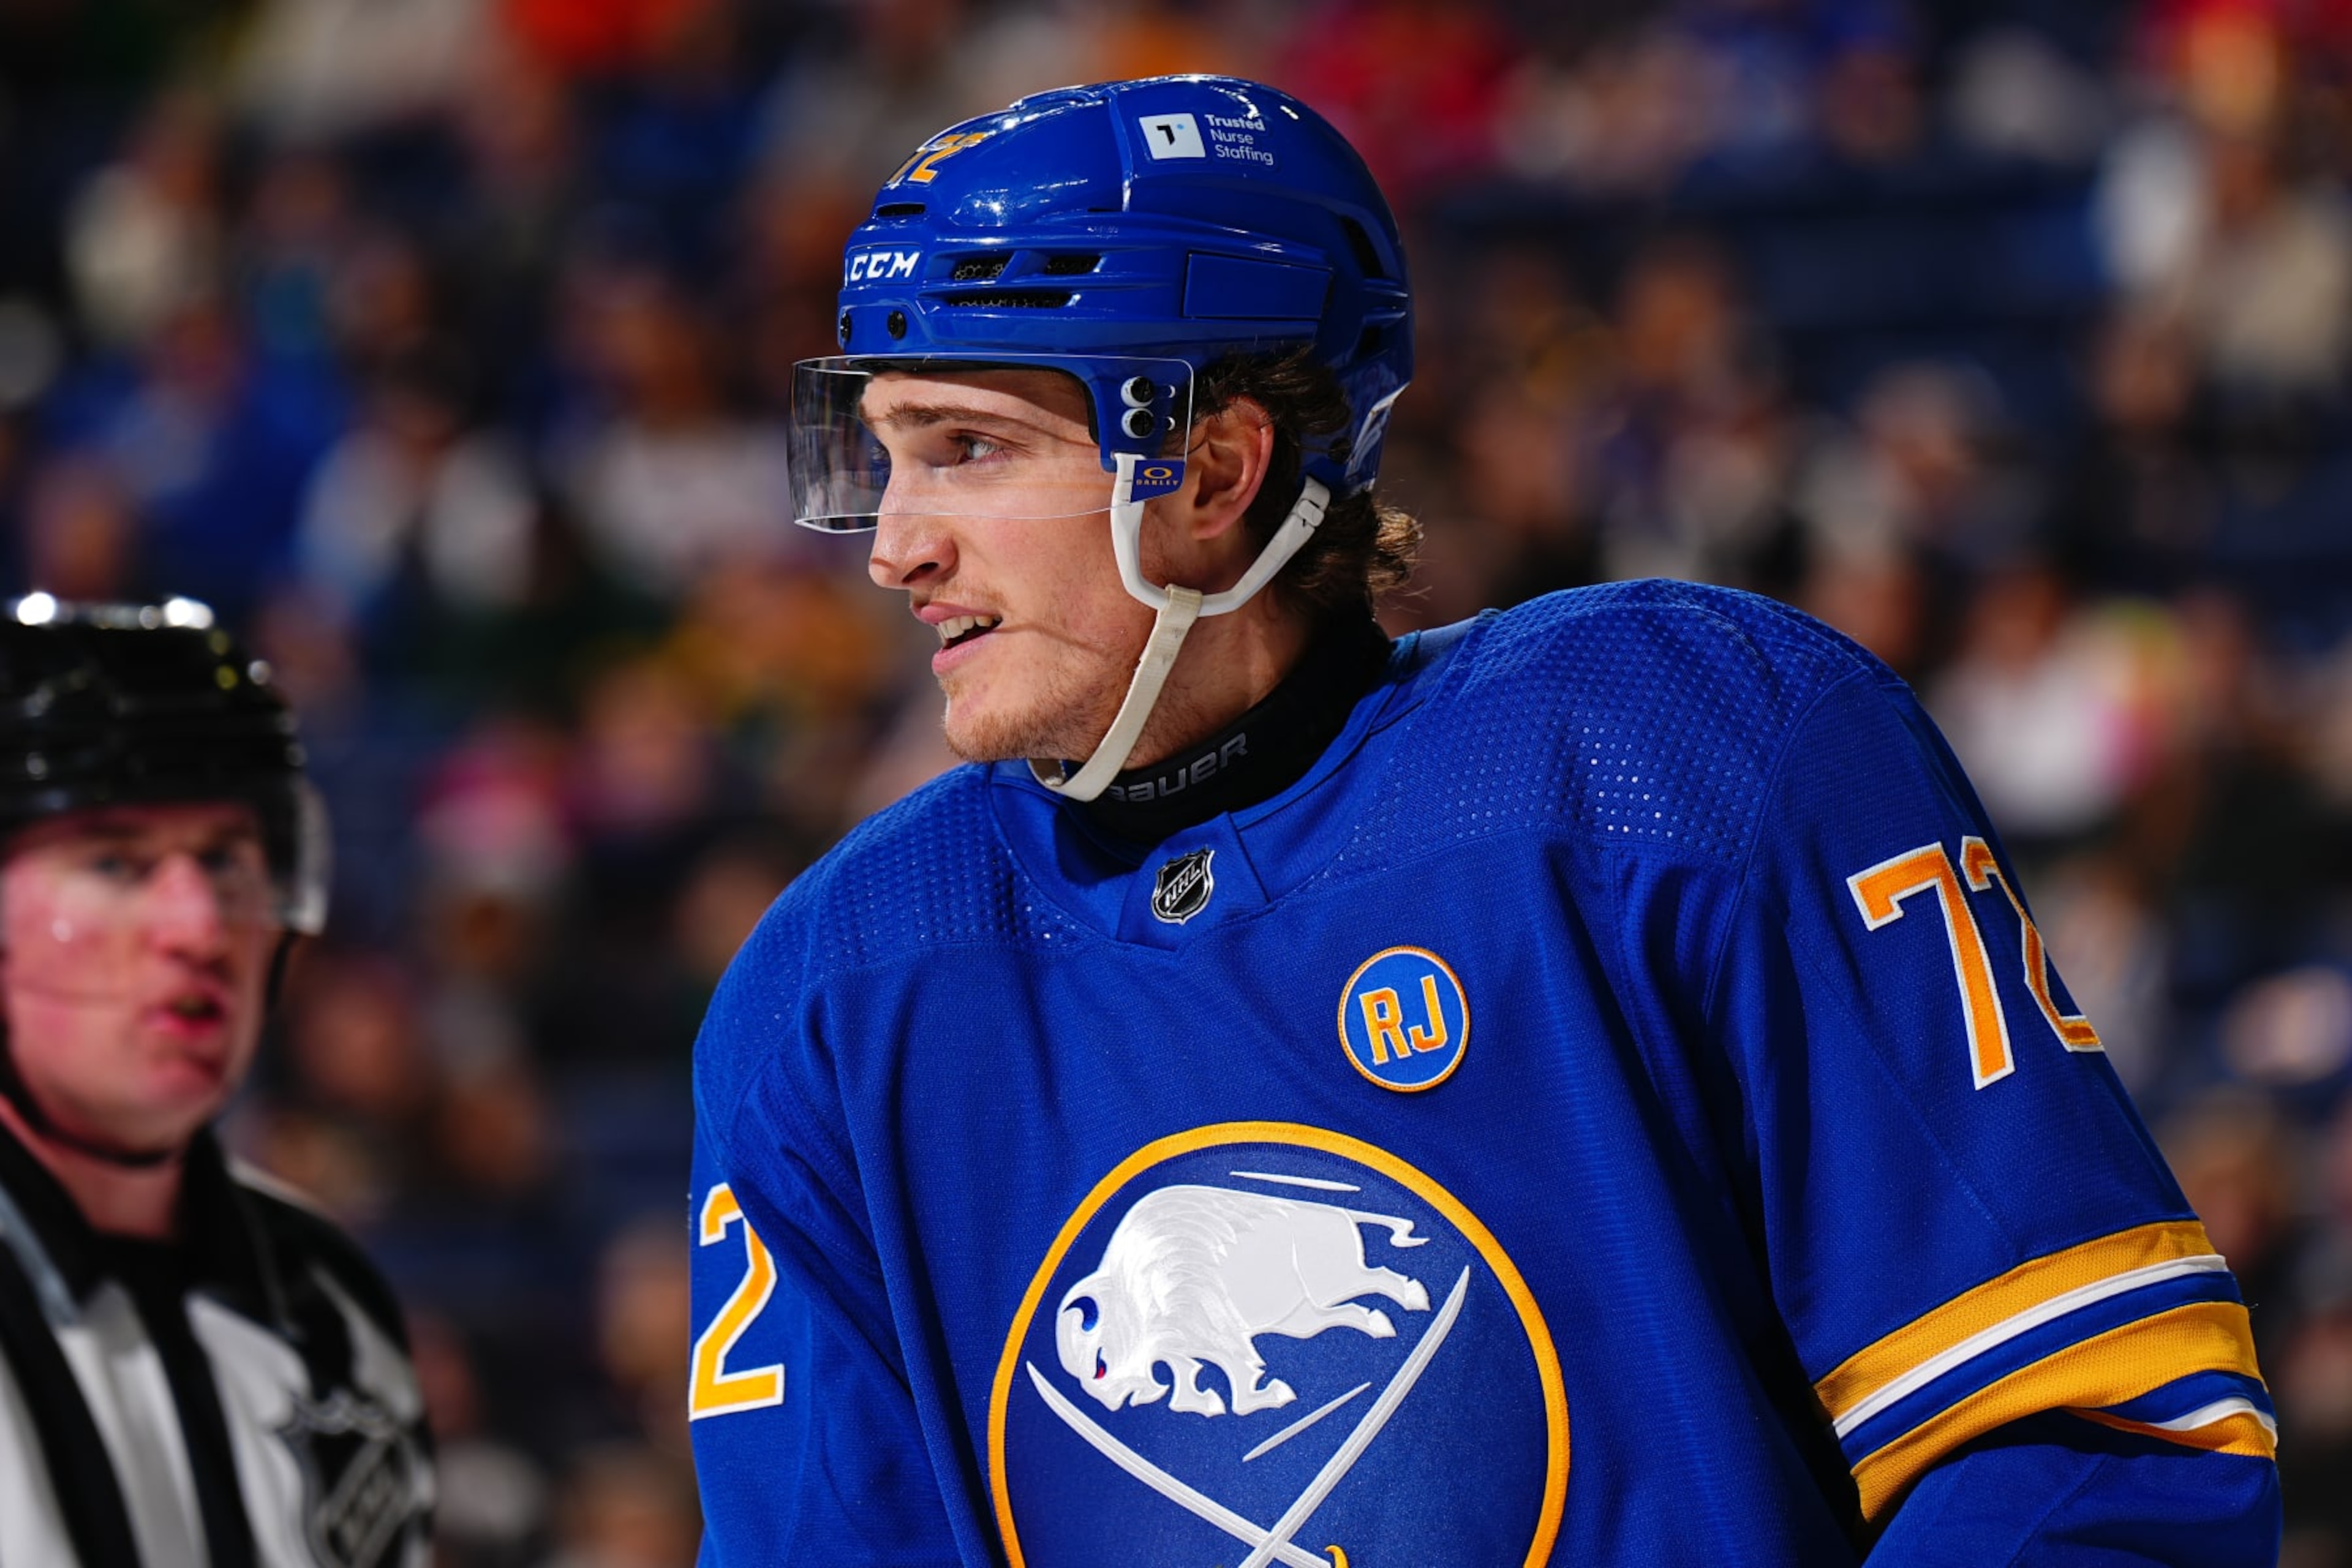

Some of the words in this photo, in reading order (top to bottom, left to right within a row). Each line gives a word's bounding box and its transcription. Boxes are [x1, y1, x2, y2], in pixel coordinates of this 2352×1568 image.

[1204, 114, 1266, 132] Trusted
[1209, 129, 1254, 145] Nurse
[1215, 144, 1274, 166] Staffing
[850, 251, 920, 282] CCM
[1164, 864, 1200, 907] NHL
[1846, 835, 2105, 1091] 72
[1359, 974, 1448, 1065] RJ
